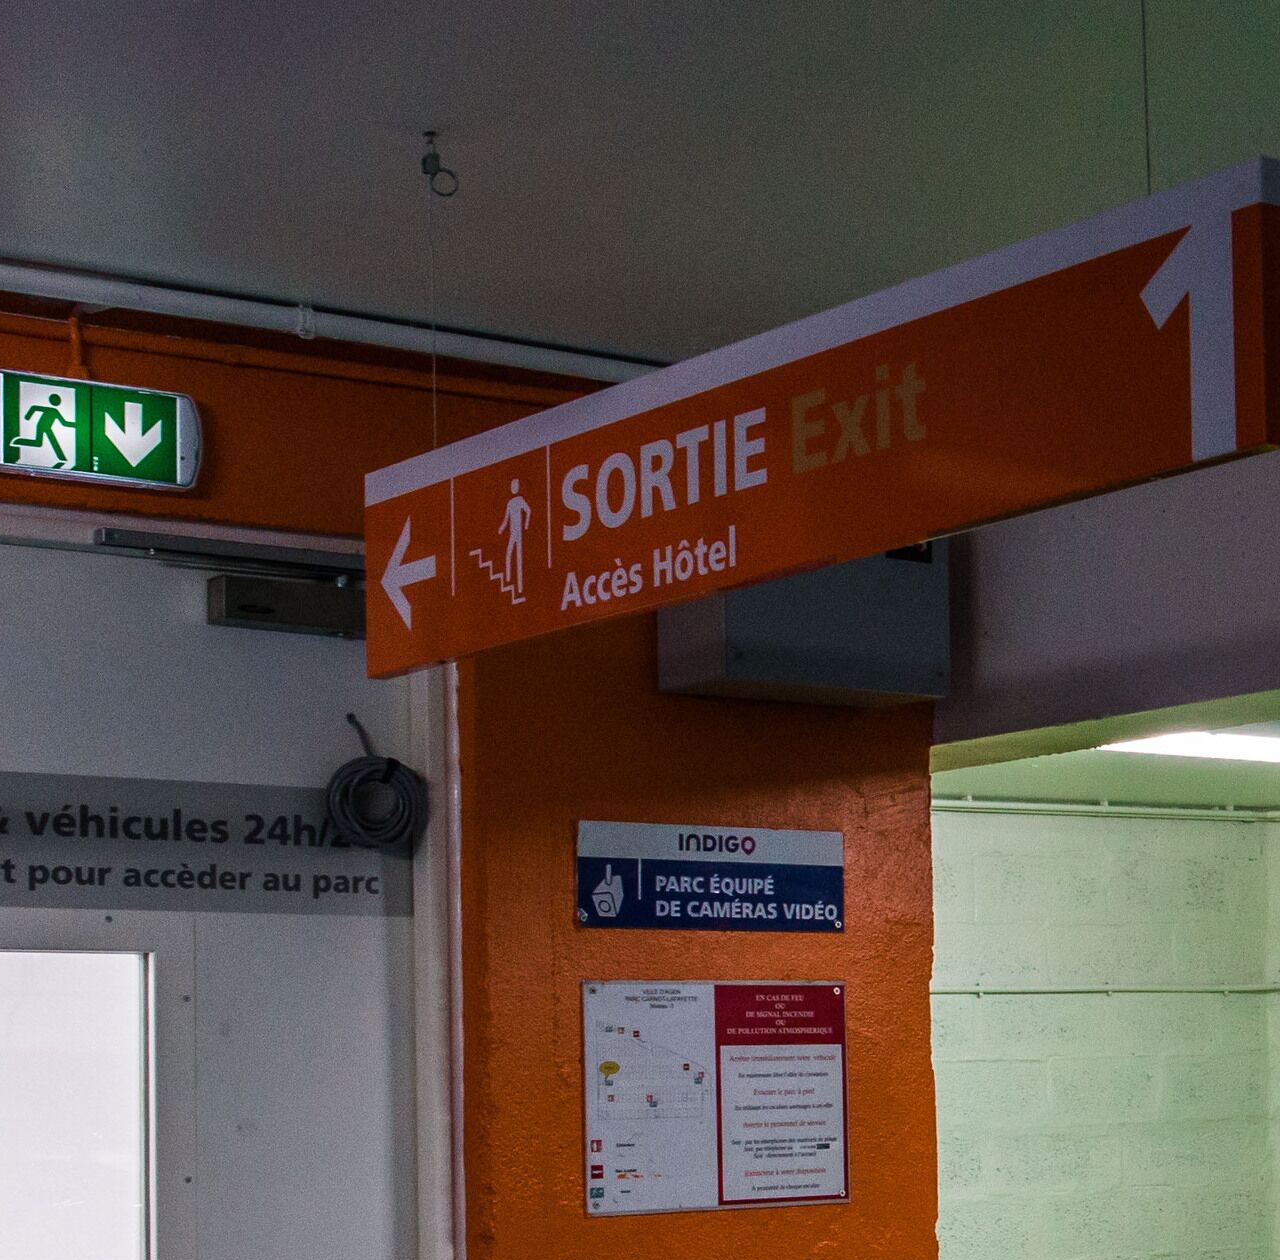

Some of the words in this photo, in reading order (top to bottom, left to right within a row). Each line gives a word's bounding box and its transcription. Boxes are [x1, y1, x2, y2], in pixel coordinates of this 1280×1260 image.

[1139, 196, 1237, 463] 1
[562, 406, 767, 542] SORTIE
[791, 362, 926, 475] Exit
[560, 557, 643, 612] Accès
[652, 523, 737, 588] Hôtel
[25, 804, 229, 845] véhicules
[679, 833, 756, 856] INDIGO
[28, 863, 112, 891] pour
[123, 863, 253, 892] accèder
[262, 871, 302, 893] au
[313, 873, 380, 900] parc
[655, 875, 705, 894] PARC
[710, 873, 776, 897] ÉQUIPÉ
[655, 900, 682, 918] DE
[687, 899, 778, 920] CAMÉRAS
[783, 901, 838, 921] VIDÉO
[755, 994, 765, 1002] EN
[766, 994, 780, 1002] CAS
[781, 994, 789, 1002] DE
[791, 994, 805, 1002] FEU
